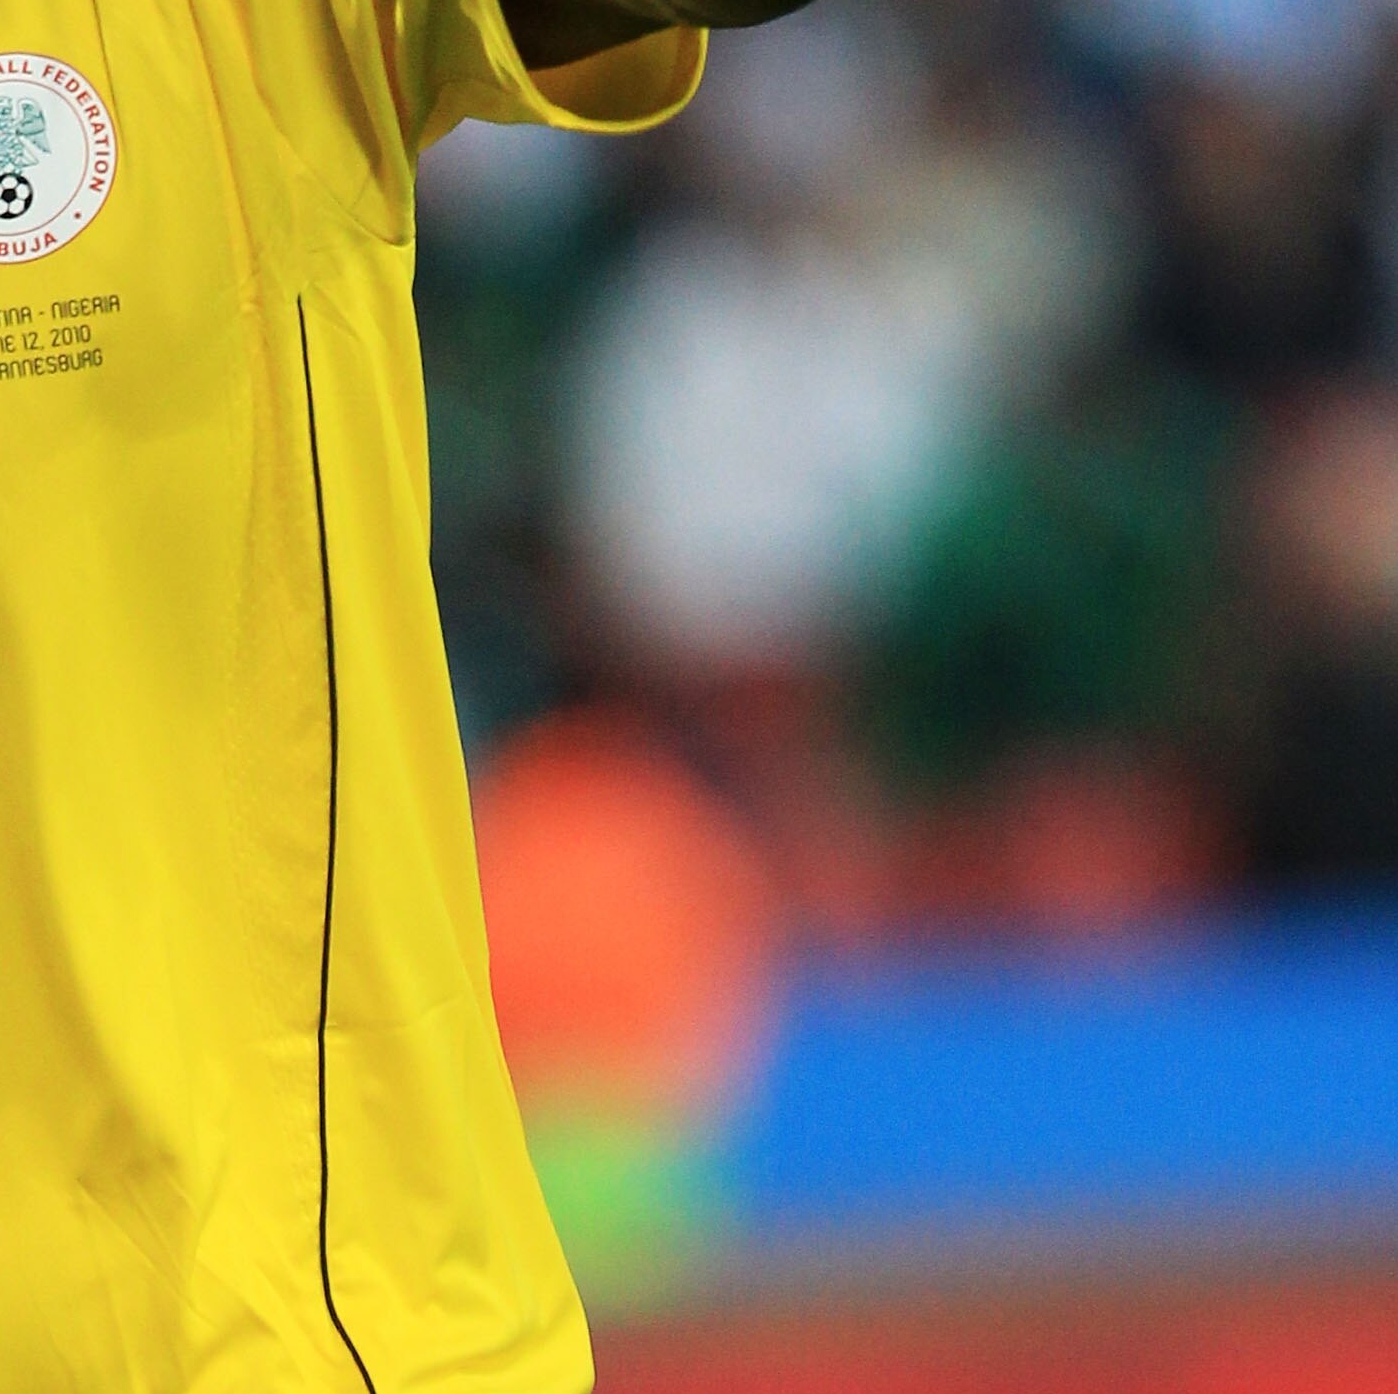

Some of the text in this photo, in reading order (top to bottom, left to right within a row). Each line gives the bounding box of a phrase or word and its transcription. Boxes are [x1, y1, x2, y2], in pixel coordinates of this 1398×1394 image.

[42, 64, 110, 192] FEDERATION
[51, 294, 120, 320] NIGERIA
[22, 332, 44, 351] 12,
[51, 325, 91, 347] 2010
